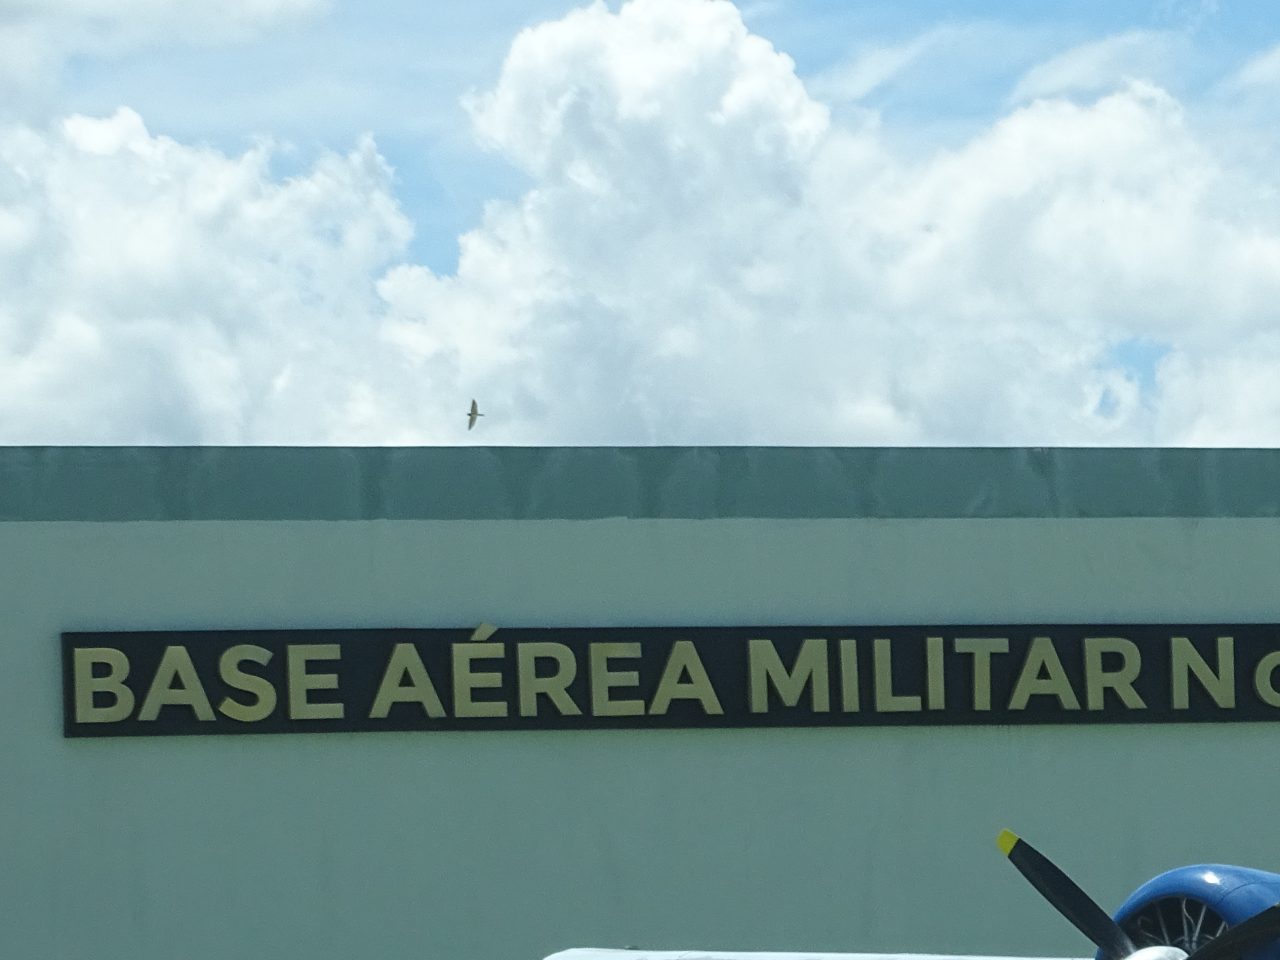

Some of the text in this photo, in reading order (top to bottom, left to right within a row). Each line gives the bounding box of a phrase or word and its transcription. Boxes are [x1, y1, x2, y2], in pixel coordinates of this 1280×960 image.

[72, 643, 345, 723] BASE
[369, 624, 724, 720] AÉREA
[748, 637, 1147, 713] MILITAR
